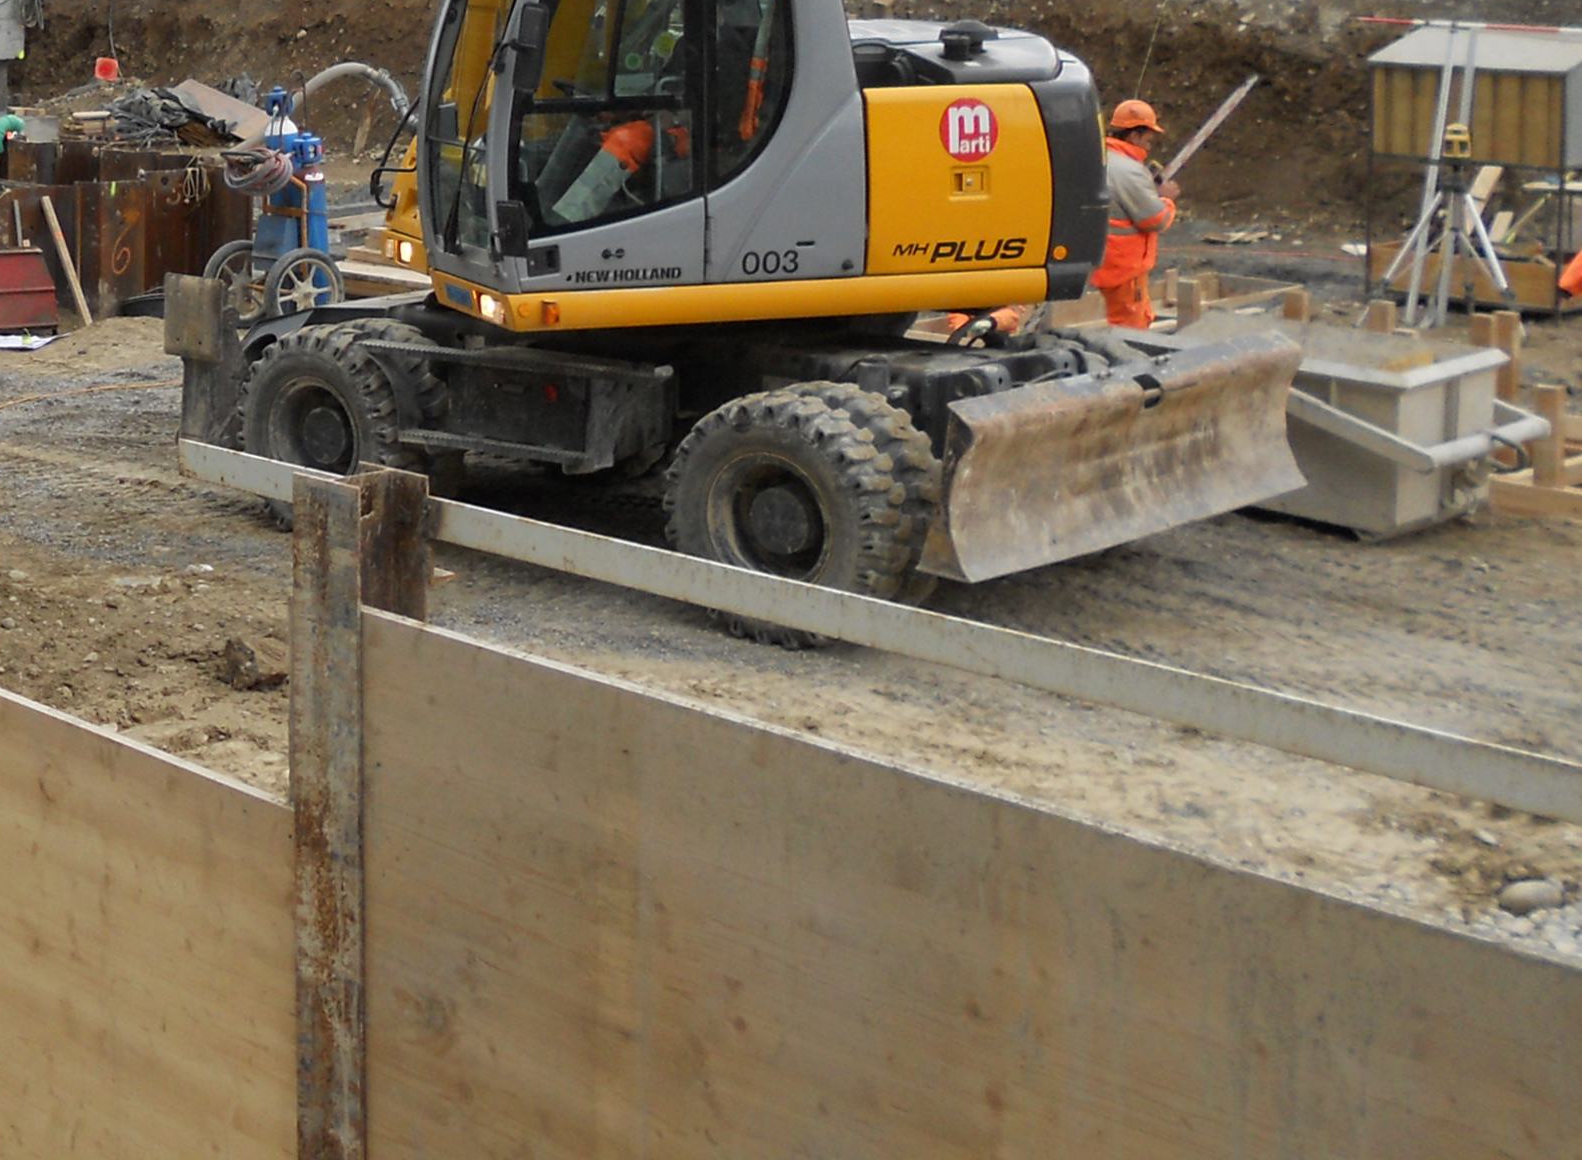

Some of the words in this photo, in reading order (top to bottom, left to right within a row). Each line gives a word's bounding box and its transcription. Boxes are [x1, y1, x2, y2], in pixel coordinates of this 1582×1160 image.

[741, 250, 799, 275] 003
[892, 242, 930, 256] MH
[929, 238, 1027, 263] PLUS
[575, 269, 611, 283] NEW
[612, 267, 682, 281] HOLLAND
